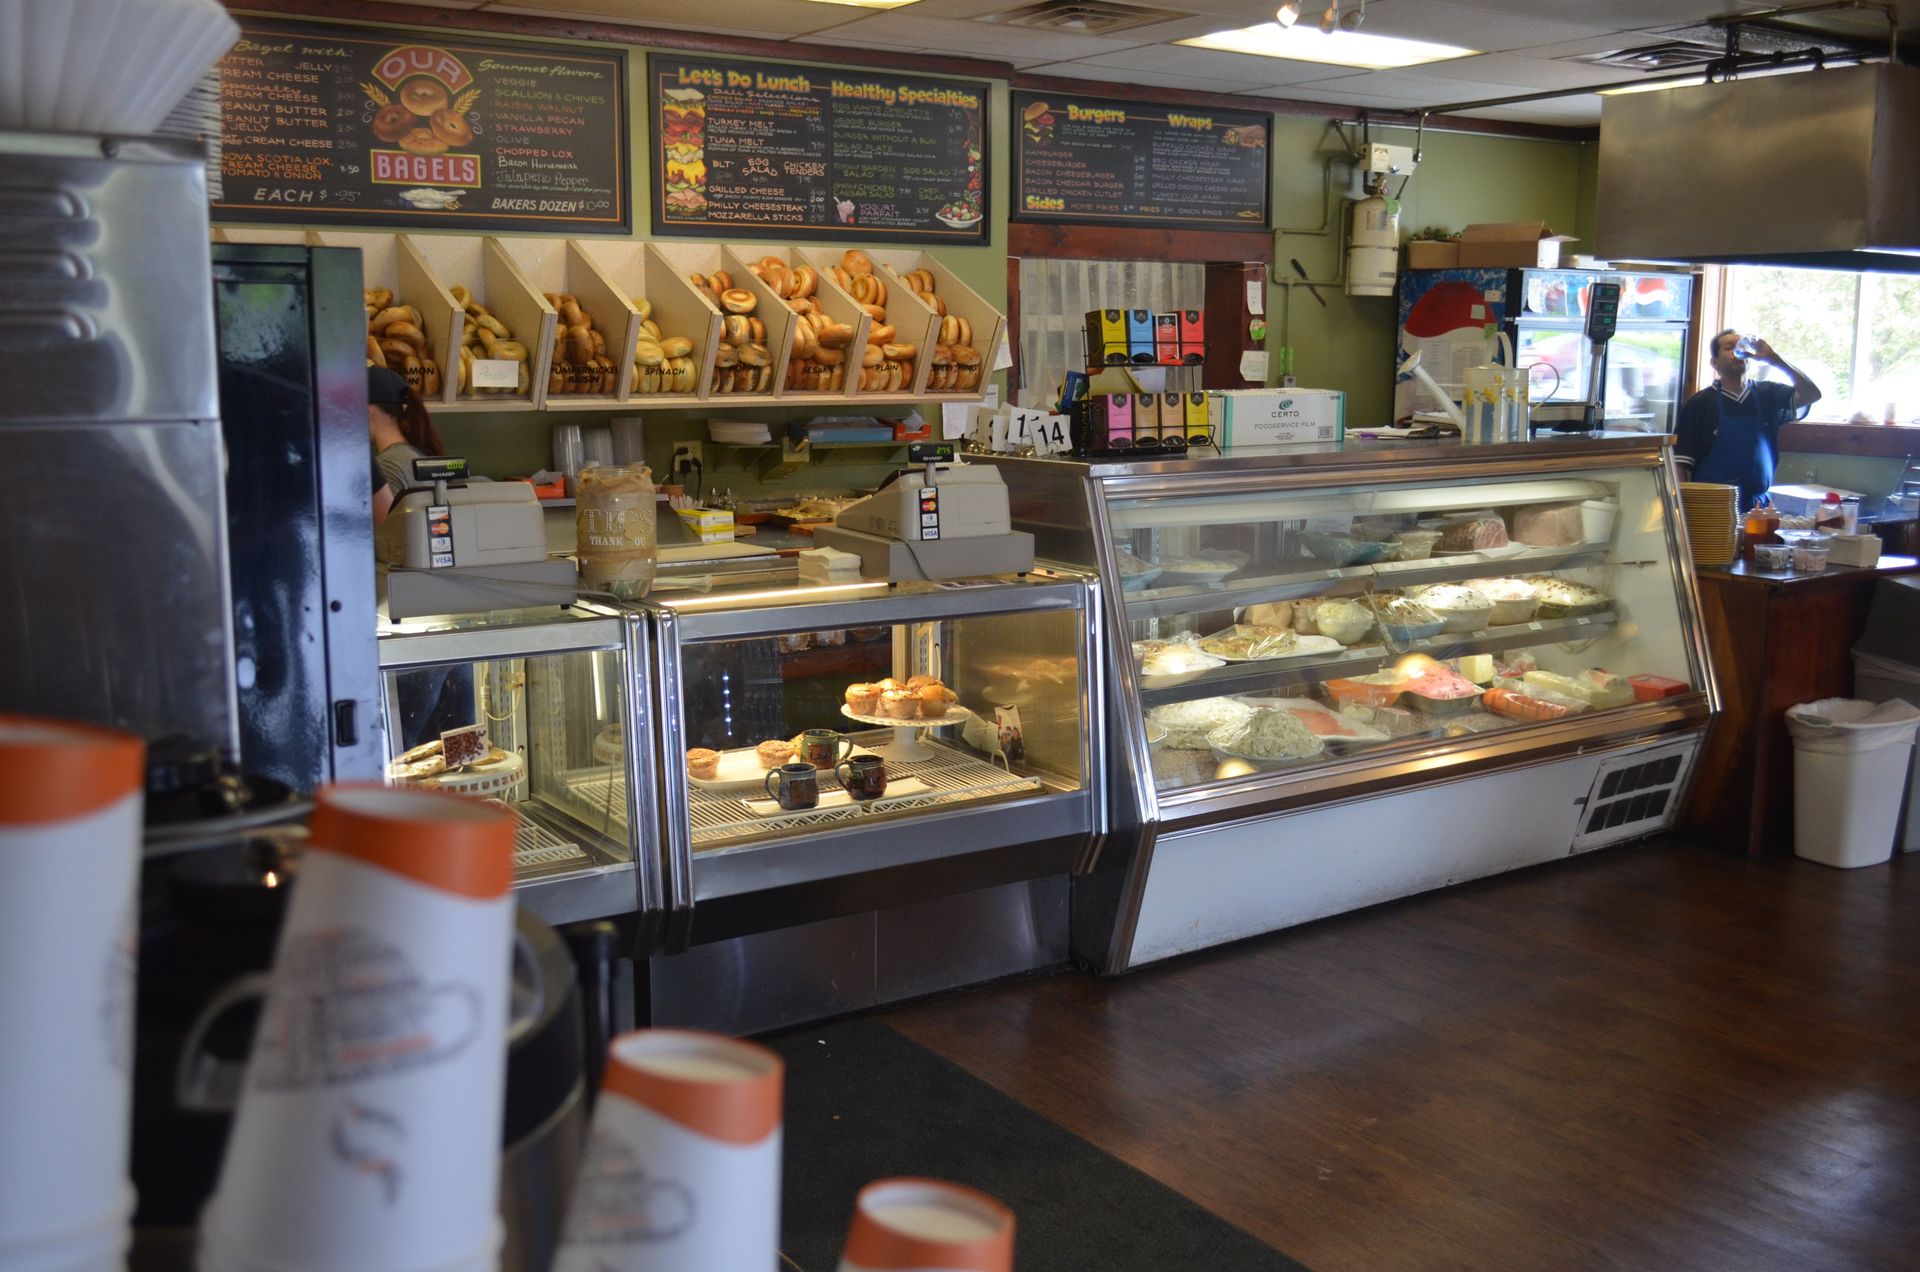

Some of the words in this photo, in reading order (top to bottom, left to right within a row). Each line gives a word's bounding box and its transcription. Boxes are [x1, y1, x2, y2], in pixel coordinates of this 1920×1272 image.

[233, 40, 294, 55] Bagel
[223, 56, 264, 67] UTTER
[295, 62, 332, 72] JELLY
[382, 50, 461, 84] OUR
[478, 59, 548, 75] Gourmet
[223, 68, 262, 79] REAM
[267, 72, 320, 84] CHEESE
[678, 67, 724, 87] Let's
[727, 70, 752, 88] Do
[756, 72, 811, 93] Lunch
[494, 78, 537, 88] VEGGIE
[222, 90, 262, 99] REAM
[268, 92, 318, 104] CHEESE
[495, 88, 552, 100] SCALLION
[564, 94, 606, 104] CHIVES
[713, 88, 744, 96] Deli
[747, 90, 820, 102] Selections
[831, 80, 896, 106] Healthy
[898, 86, 978, 109] Specialties
[275, 104, 328, 116] BUTTER
[496, 100, 533, 110] RAISIN
[538, 102, 585, 114] WALNUT
[496, 112, 544, 122] VANILLA
[548, 116, 585, 126] PECAN
[1068, 104, 1126, 124] Burgers
[230, 123, 269, 132] JELLY
[276, 118, 328, 128] BUTTER
[708, 118, 746, 127] TURKEY
[749, 121, 775, 129] MELT
[833, 118, 864, 126] VEGGIE
[868, 120, 902, 128] BURGER
[1168, 114, 1212, 130] Wraps
[496, 124, 574, 136] STRAWBERRY
[244, 136, 286, 146] CREAM
[289, 138, 334, 149] CHEESE
[496, 136, 530, 144] OLIVE
[708, 136, 736, 144] TUNA
[739, 138, 765, 146] MELT
[832, 131, 869, 140] BURGER
[872, 134, 908, 143] WITHOUT
[496, 146, 548, 158] CHOPPED
[552, 150, 574, 158] LOX
[833, 142, 862, 150] SALAD
[866, 144, 893, 152] PLATE
[222, 152, 252, 161] NOVA
[256, 154, 302, 163] SCOTIA
[1026, 150, 1073, 158] HAMBURGER
[222, 160, 264, 170] CREAM
[498, 156, 528, 168] Bacon
[748, 158, 770, 167] EGG
[1026, 159, 1087, 168] CHEESEBURGER
[1168, 159, 1198, 167] CHICKEN
[378, 154, 475, 182] BAGELS
[742, 166, 778, 178] SALAD
[784, 168, 825, 178] TENDERS
[860, 165, 896, 173] GARDEN
[922, 168, 950, 176] SALAD
[222, 168, 270, 178] TOMATO
[284, 172, 322, 180] ONION
[844, 170, 874, 178] SALAD
[1026, 168, 1052, 176] BACON
[1056, 170, 1116, 180] CHEESEBURGER
[555, 172, 590, 188] Pepper
[1056, 180, 1092, 188] CHEDDAR
[750, 188, 785, 196] CHEESE
[859, 184, 895, 192] CHICKEN
[1026, 187, 1058, 195] GRILLED
[1061, 189, 1092, 197] CHICKEN
[1094, 190, 1122, 198] CUTLET
[1178, 184, 1202, 192] CHICKEN
[254, 188, 314, 203] EACH
[492, 198, 537, 211] BAKERS
[539, 200, 577, 212] DOZEN
[708, 201, 740, 210] PHILLY
[1026, 194, 1065, 210] Sides
[1178, 208, 1200, 216] ONION
[1202, 208, 1223, 216] RINGS
[708, 212, 770, 221] MOZZARELLA
[772, 214, 804, 222] STICKS
[860, 209, 900, 217] PARFAIT
[552, 366, 620, 375] PUMPERNICKEL
[645, 368, 686, 376] SPINACH
[803, 366, 835, 374] SESAME
[876, 364, 898, 372] PLAIN
[569, 376, 600, 384] RAISIN
[1254, 422, 1300, 430] FOODSERVICE
[1038, 421, 1064, 446] 14
[589, 536, 624, 546] THANK
[435, 556, 452, 564] VISA
